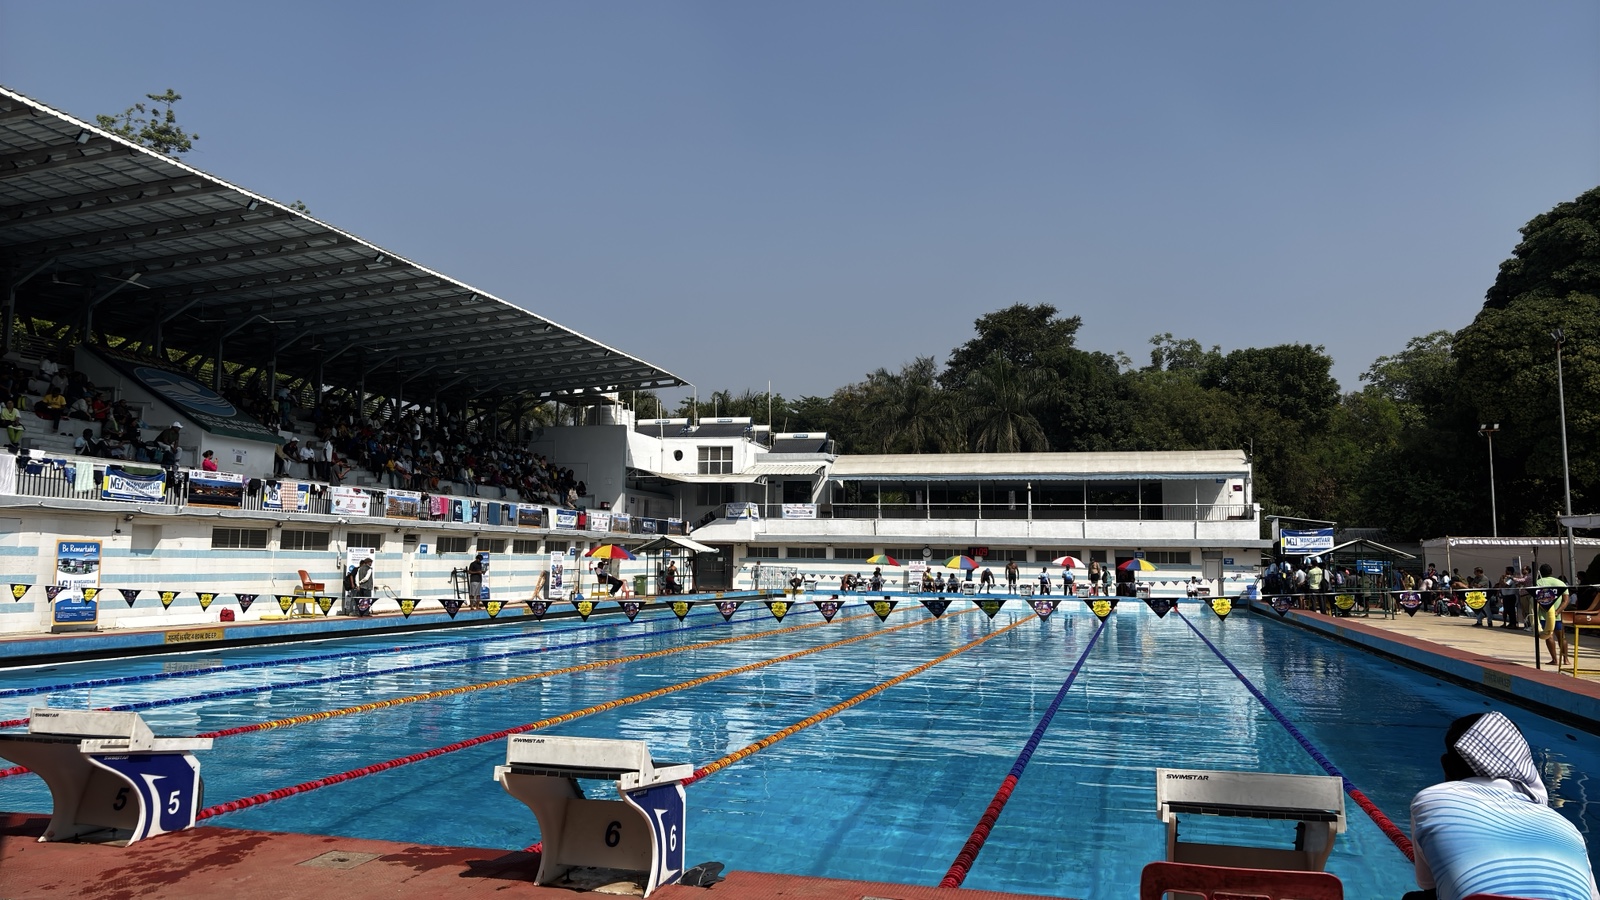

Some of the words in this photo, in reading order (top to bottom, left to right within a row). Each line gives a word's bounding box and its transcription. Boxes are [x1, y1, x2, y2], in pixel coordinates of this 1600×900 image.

[62, 543, 69, 552] Be
[70, 544, 97, 553] Remarkable
[1166, 773, 1210, 781] SWIMSTAR
[113, 787, 130, 811] 5
[167, 789, 181, 815] 5
[604, 820, 622, 848] 6
[669, 824, 677, 852] 6
